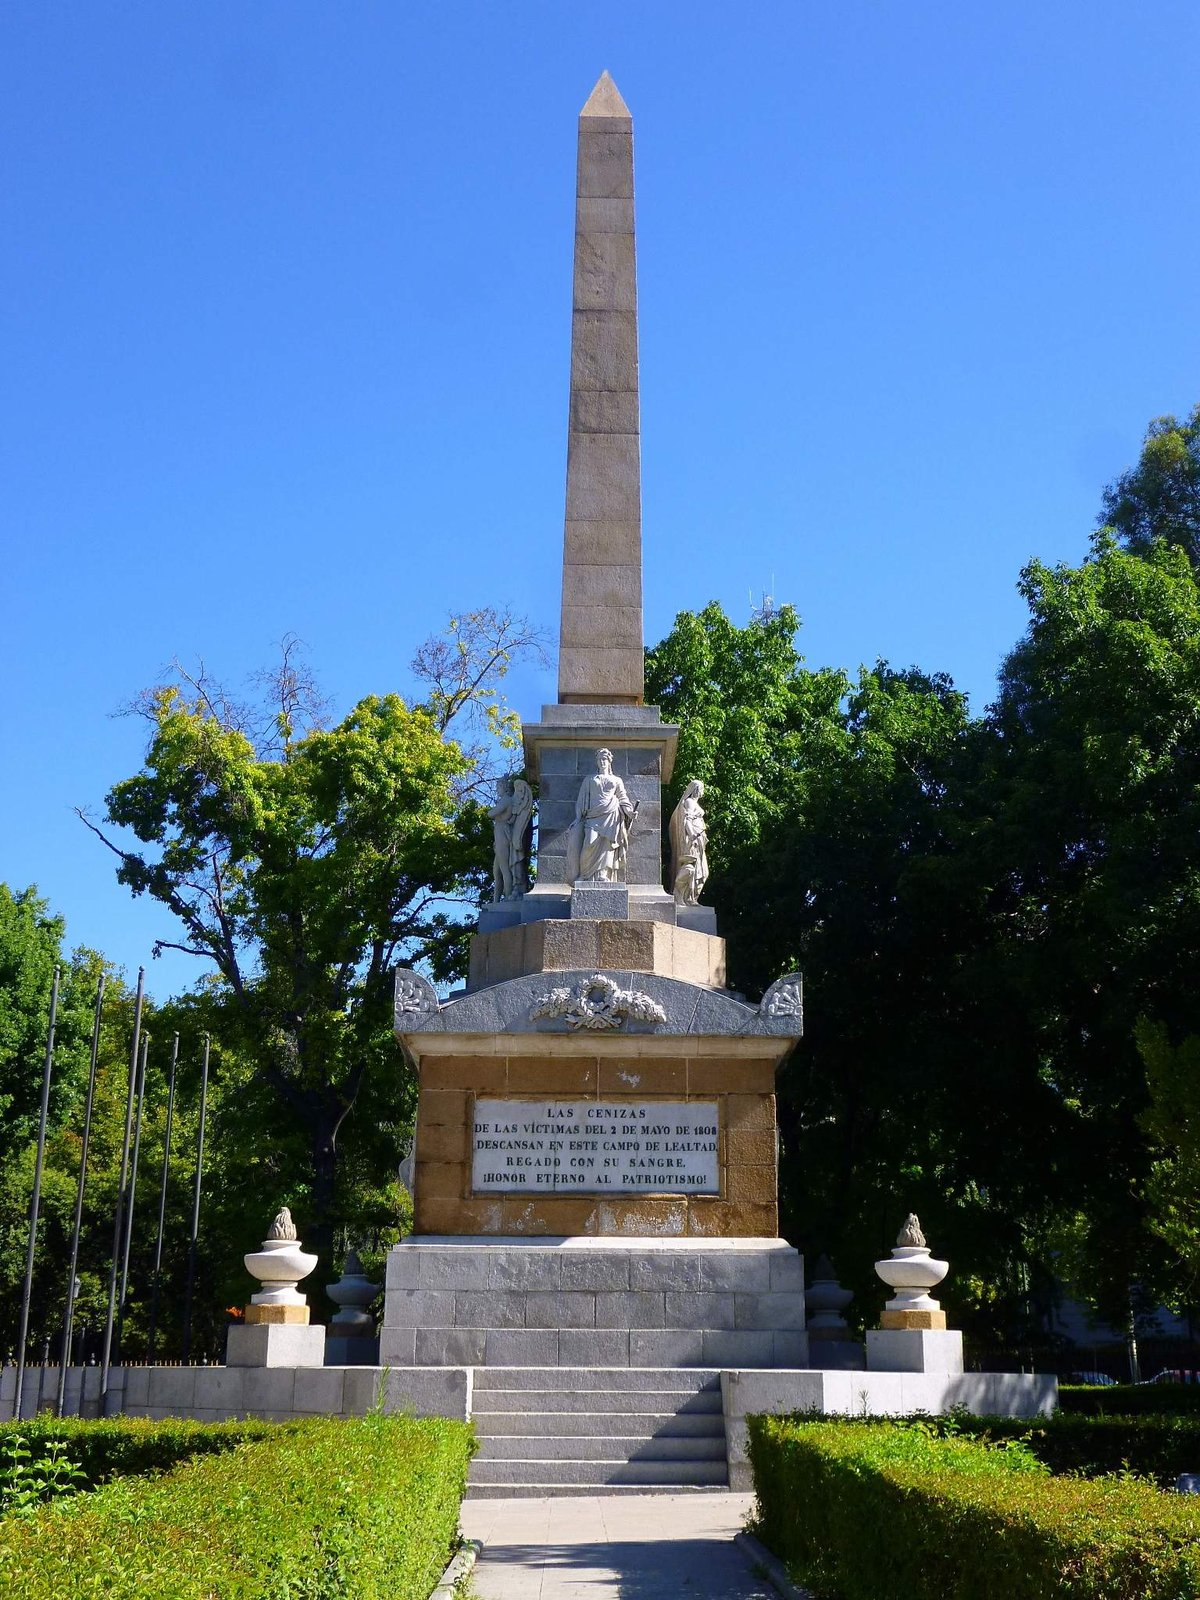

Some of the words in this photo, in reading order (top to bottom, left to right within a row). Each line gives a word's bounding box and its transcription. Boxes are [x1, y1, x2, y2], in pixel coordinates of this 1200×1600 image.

[547, 1108, 574, 1118] LAS
[587, 1108, 646, 1119] CENIZAS
[474, 1123, 490, 1134] DE
[494, 1123, 518, 1134] LAS
[523, 1121, 580, 1135] VÍCTIMAS
[585, 1124, 607, 1135] DEL
[610, 1125, 617, 1135] 2
[622, 1125, 637, 1135] DE
[640, 1125, 671, 1136] MAYO
[675, 1125, 690, 1136] DE
[693, 1125, 717, 1136] 1808
[476, 1140, 544, 1151] DESCANSAN
[549, 1140, 564, 1151] EN
[569, 1141, 598, 1152] ESTE
[603, 1141, 640, 1152] CAMPO
[645, 1141, 660, 1152] DE
[506, 1156, 561, 1167] REGADO
[570, 1157, 595, 1168] CON
[603, 1157, 619, 1168] SU
[629, 1157, 686, 1168] SANGRE.
[483, 1172, 526, 1184] ¡HONOR
[536, 1173, 585, 1183] ETERNO
[595, 1174, 612, 1184] AL
[621, 1173, 707, 1185] PATRIOTISMO!
